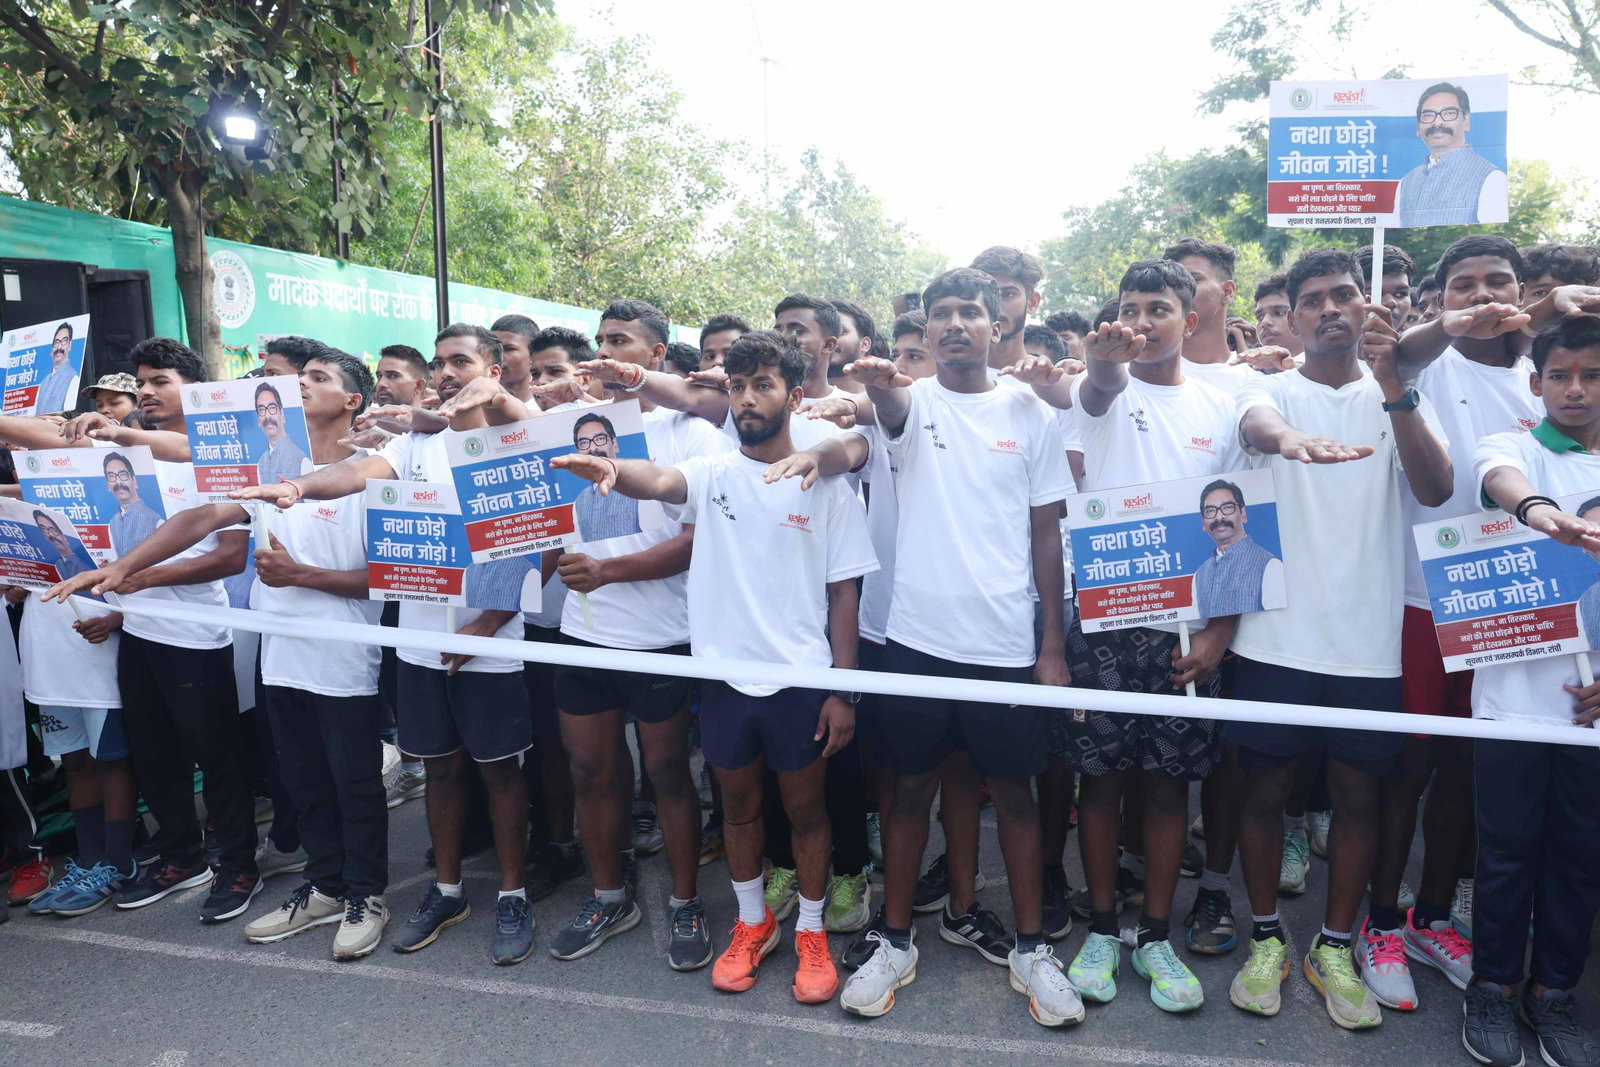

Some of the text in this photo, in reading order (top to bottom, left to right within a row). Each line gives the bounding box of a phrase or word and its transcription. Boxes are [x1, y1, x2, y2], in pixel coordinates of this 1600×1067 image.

[1290, 120, 1376, 148] नशा छोड़ो
[1278, 150, 1388, 178] जीवन जोड़ो !
[266, 272, 318, 307] मादक
[320, 277, 368, 315] पदार्थों
[368, 288, 390, 318] पर
[390, 284, 417, 320] रोक
[418, 289, 436, 321] के
[195, 415, 238, 438] नशा छोड़ो
[194, 440, 250, 463] जीवन जोड़ो !
[471, 455, 544, 486] नशा छोड़ो
[33, 480, 86, 501] नशा छोड़ो
[468, 482, 562, 514] जीवन जोड़ो !
[66, 502, 92, 524] जोड़ो
[382, 516, 446, 540] नशा छोड़ो
[1090, 522, 1166, 551] नशा छोड़ो
[375, 538, 456, 565] जीवन जोड़ो !
[1083, 550, 1182, 580] जीवन जोड़ो !
[1444, 547, 1537, 582] नशा छोड़ो
[1439, 577, 1560, 614] जीवन जोड़ो !
